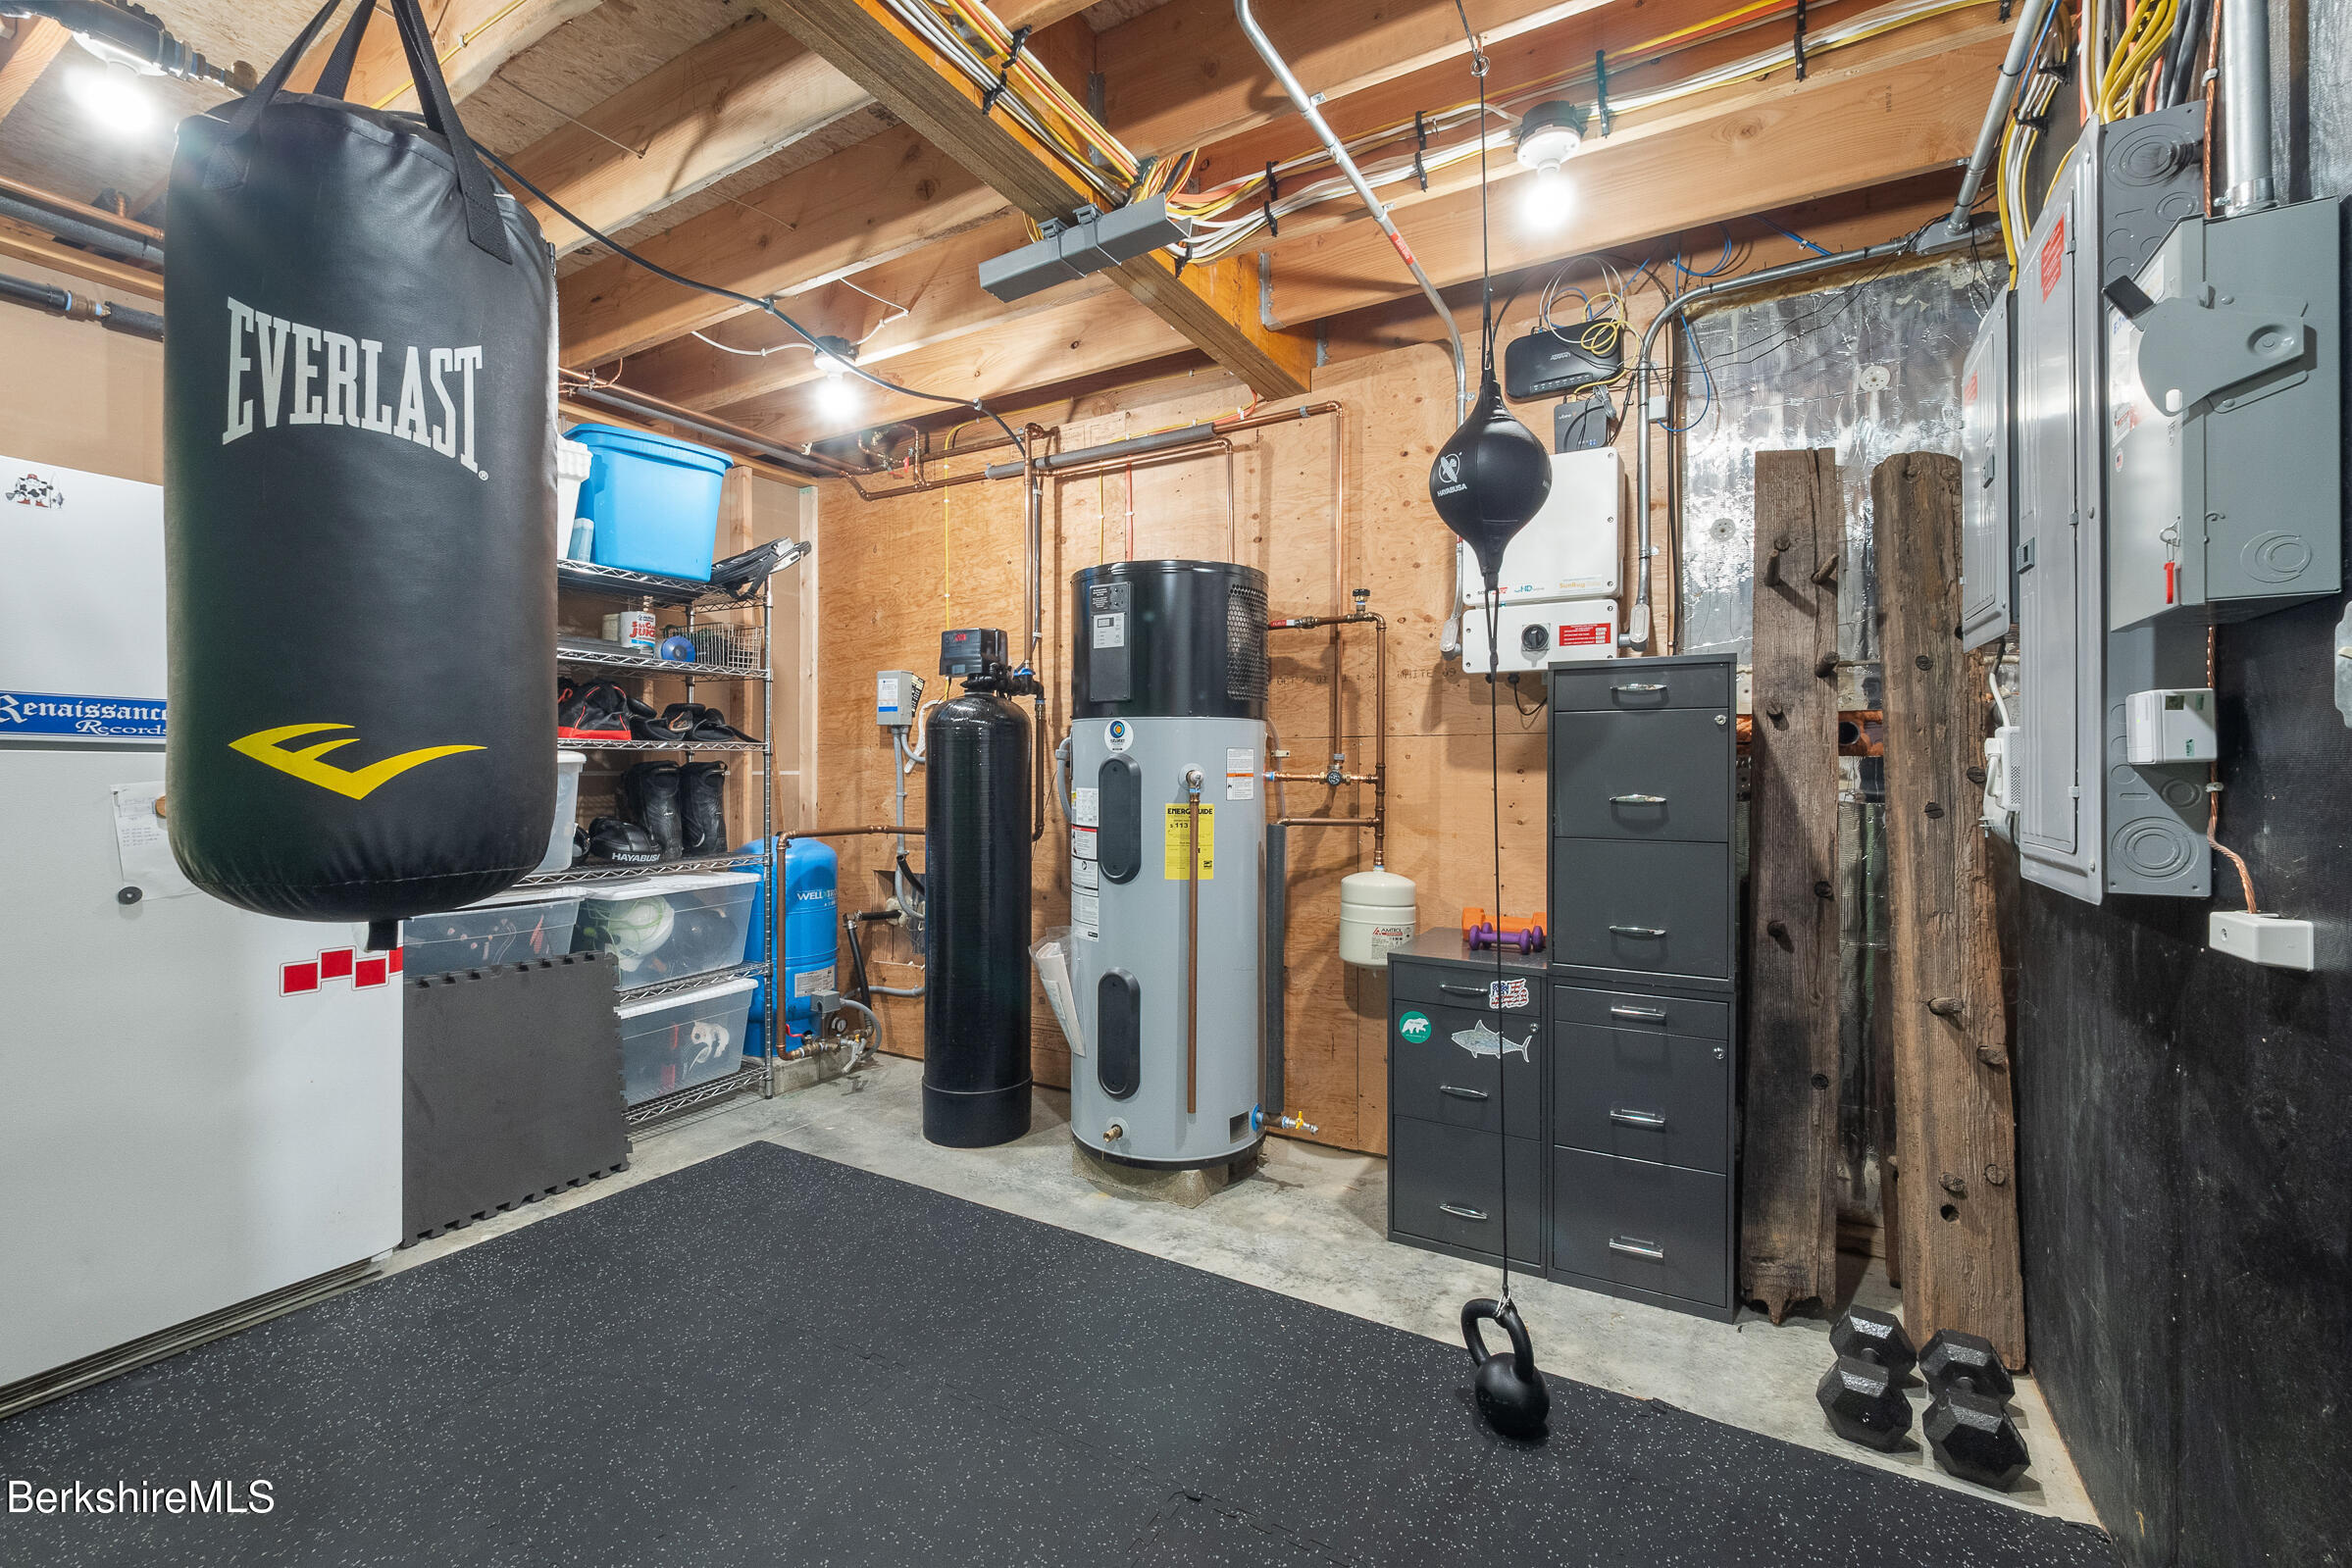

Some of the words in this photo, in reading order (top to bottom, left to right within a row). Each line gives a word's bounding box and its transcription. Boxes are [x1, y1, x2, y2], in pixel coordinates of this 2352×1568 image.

[223, 296, 484, 474] EVERLAST
[1437, 482, 1468, 497] HAYABUSA
[629, 627, 656, 638] JUIC
